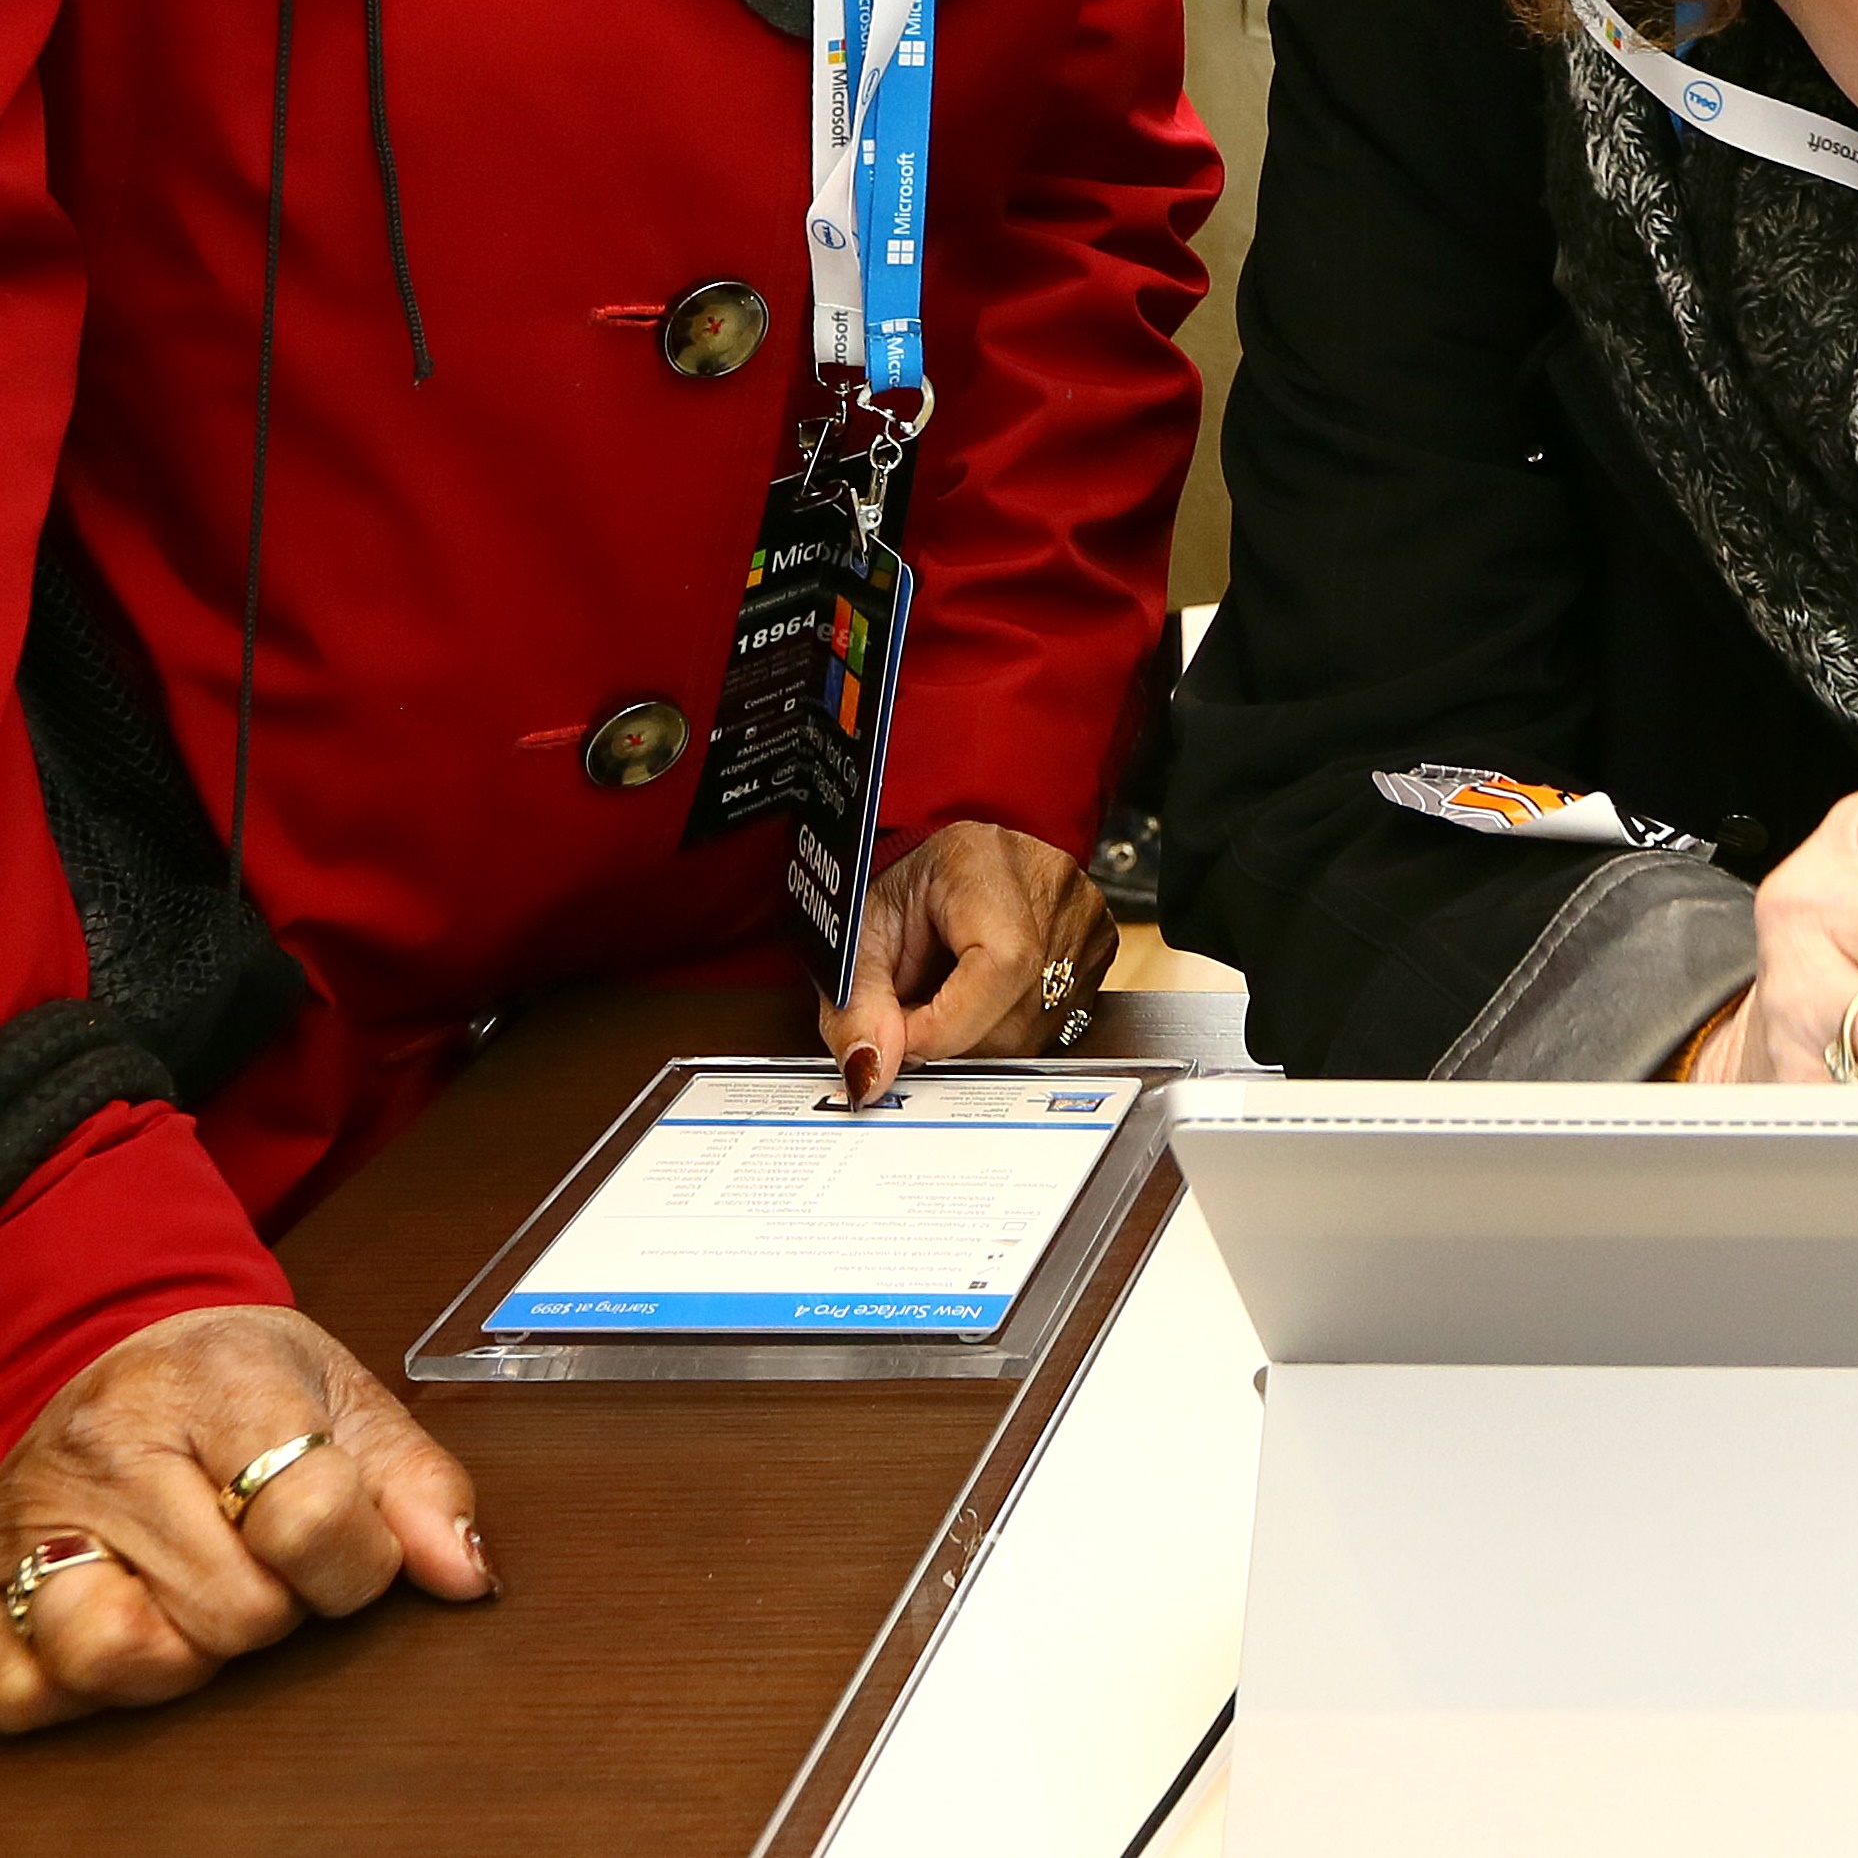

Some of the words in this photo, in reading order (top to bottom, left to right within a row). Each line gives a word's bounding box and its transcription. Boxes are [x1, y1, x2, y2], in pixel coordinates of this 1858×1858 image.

[831, 69, 850, 149] Microsoft
[893, 152, 916, 236] Microsoft
[737, 609, 816, 655] 18964
[744, 689, 783, 710] Connect
[843, 755, 861, 798] City
[721, 778, 760, 804] DELL
[798, 823, 841, 896] GRAND
[787, 859, 840, 949] OPENING
[530, 1301, 573, 1316] $899
[576, 1302, 595, 1315] at
[597, 1300, 660, 1317] Starting
[793, 1304, 811, 1319] 4
[812, 1304, 850, 1319] Pro
[853, 1303, 931, 1320] Surface
[932, 1303, 982, 1320] New
